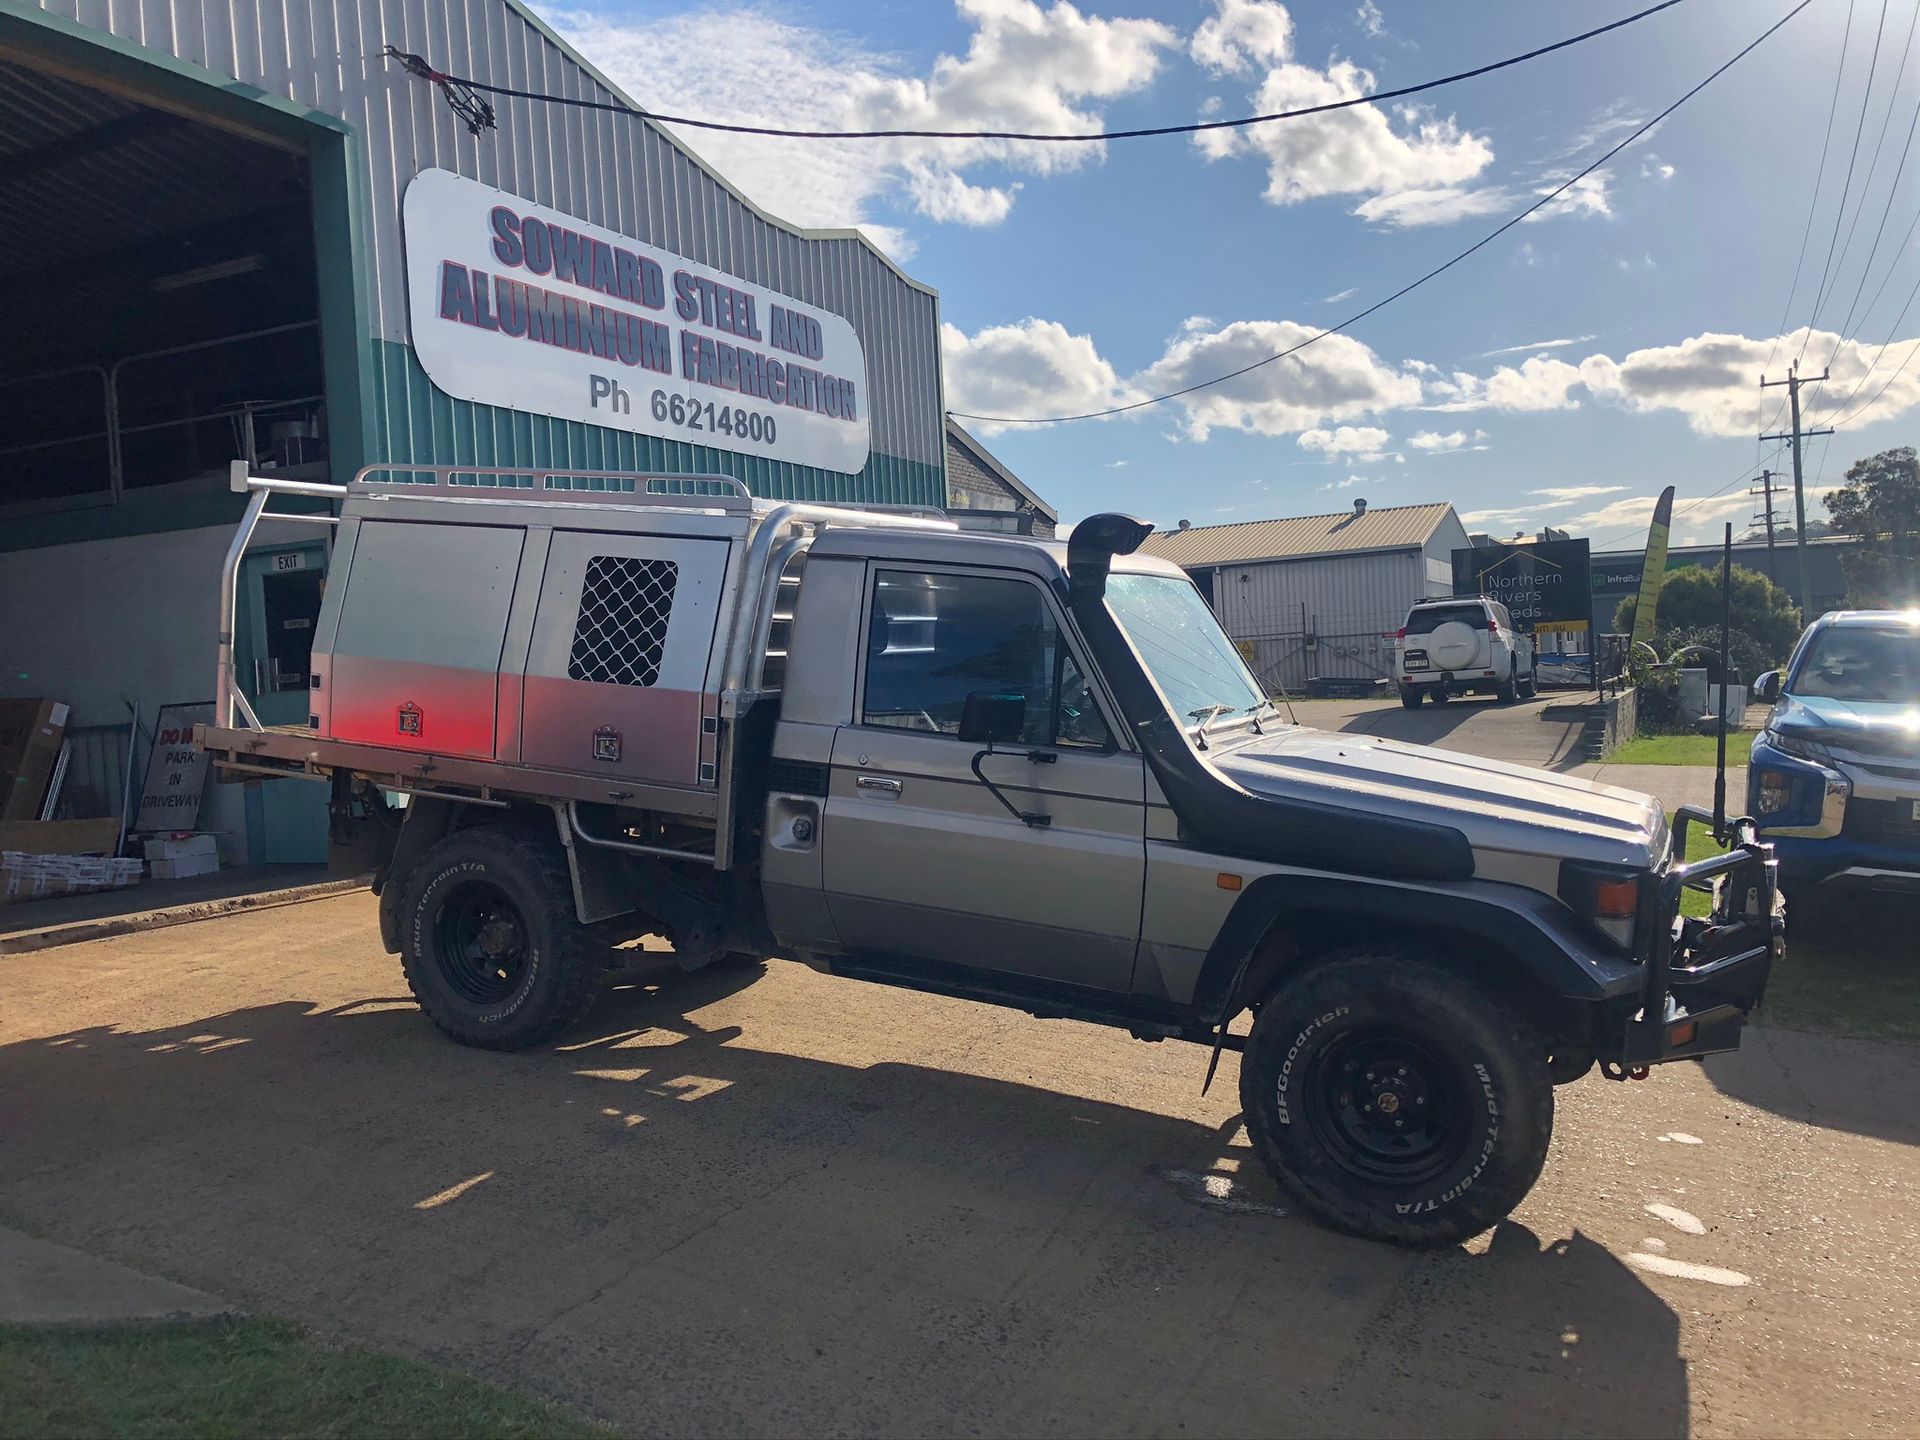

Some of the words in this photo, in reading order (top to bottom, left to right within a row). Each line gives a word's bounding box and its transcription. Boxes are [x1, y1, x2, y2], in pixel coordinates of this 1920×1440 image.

[490, 205, 666, 311] SOWARD
[673, 269, 762, 342] STEEL
[770, 303, 823, 361] AND
[439, 259, 673, 376] ALUMINIUM
[680, 329, 857, 422] FABRICATION
[589, 374, 630, 415] Ph
[651, 389, 776, 445] 66214800
[278, 555, 298, 569] EXIT
[1489, 573, 1562, 588] Northern
[1607, 573, 1641, 583] InfraBui
[1510, 604, 1542, 619] eds
[160, 728, 180, 745] DO
[166, 752, 194, 765] PARK
[168, 773, 181, 785] IN
[142, 795, 200, 808] DRIVEWAY
[414, 866, 459, 957] Mud-Terrain
[460, 862, 486, 872] T/A
[1276, 1006, 1350, 1125] BFGoodrich
[1441, 1063, 1500, 1204] Mud-Terrain
[1395, 1199, 1440, 1213] T/A
